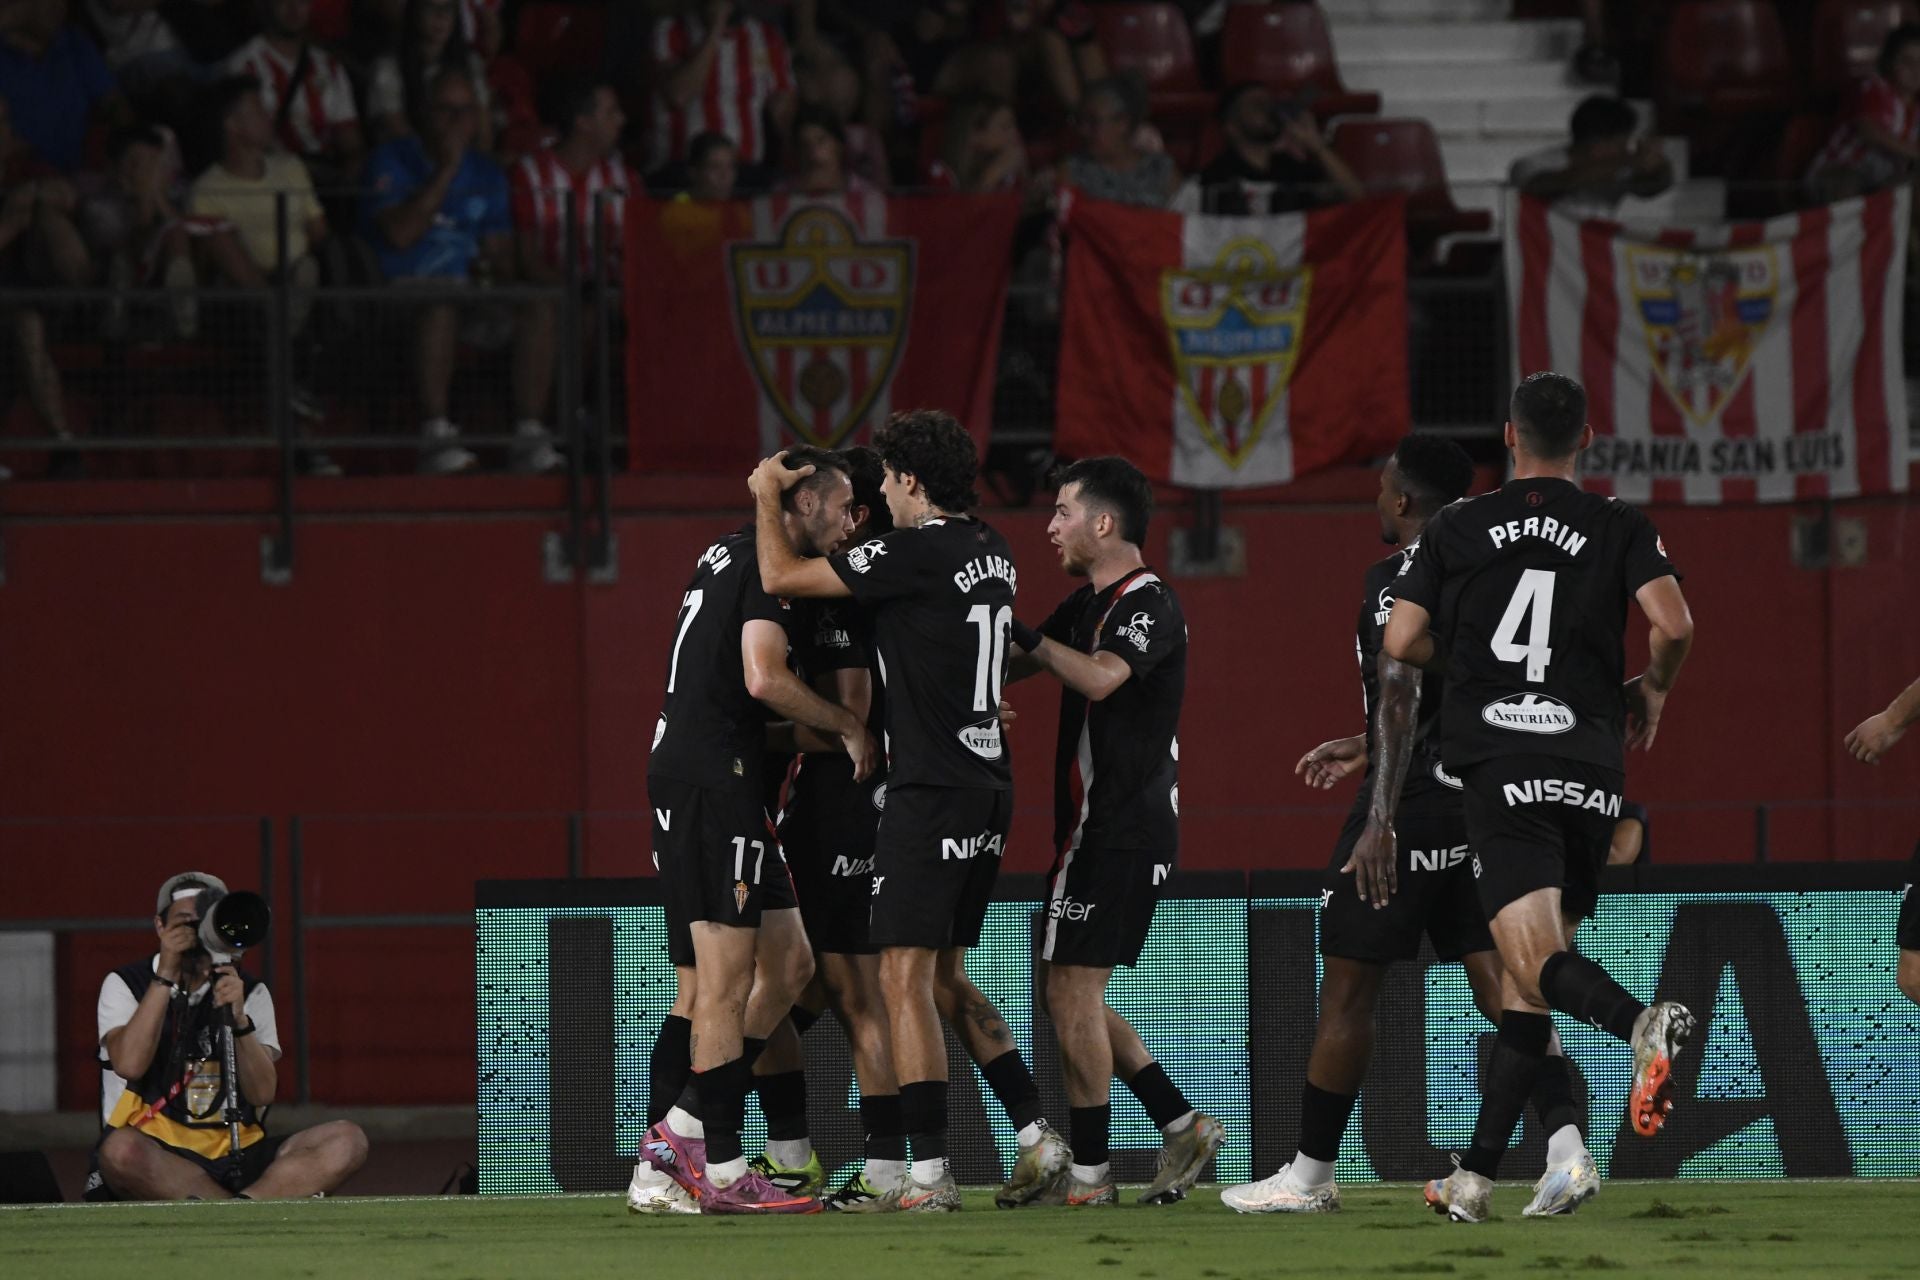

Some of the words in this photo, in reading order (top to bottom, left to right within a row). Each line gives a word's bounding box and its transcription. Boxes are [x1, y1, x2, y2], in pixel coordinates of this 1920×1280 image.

[1709, 438, 1775, 473] SAN
[1785, 432, 1845, 470] LUIS
[1488, 516, 1587, 557] PERRIN
[1490, 568, 1556, 683] 4
[966, 604, 1013, 712] 10
[1493, 709, 1569, 725] ASTURIANA
[1503, 779, 1622, 818] NISSAN
[731, 836, 765, 884] 17
[1410, 844, 1470, 871] NIS
[1048, 896, 1096, 921] sfer
